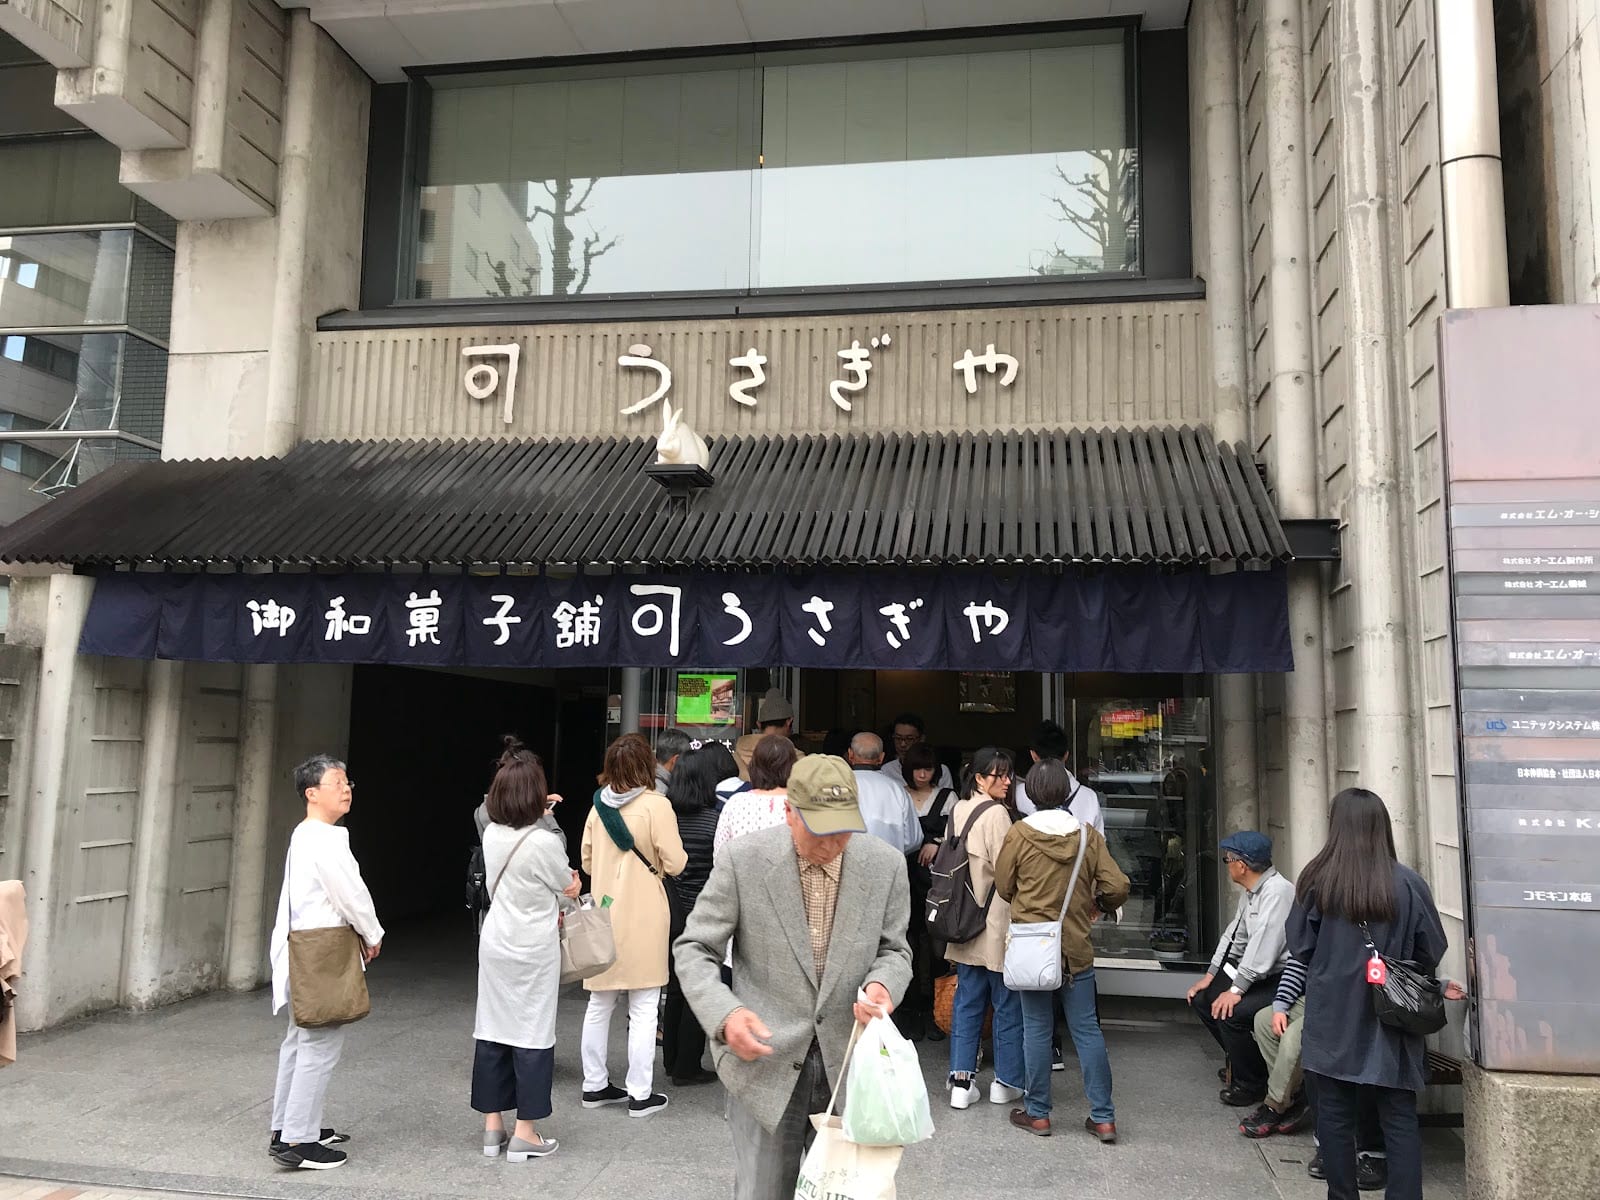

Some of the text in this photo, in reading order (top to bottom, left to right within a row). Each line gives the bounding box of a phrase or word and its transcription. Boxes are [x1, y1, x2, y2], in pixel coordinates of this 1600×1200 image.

[1508, 648, 1600, 660] 株式会社エム・オー・
[1523, 890, 1592, 903] コモキン本店
